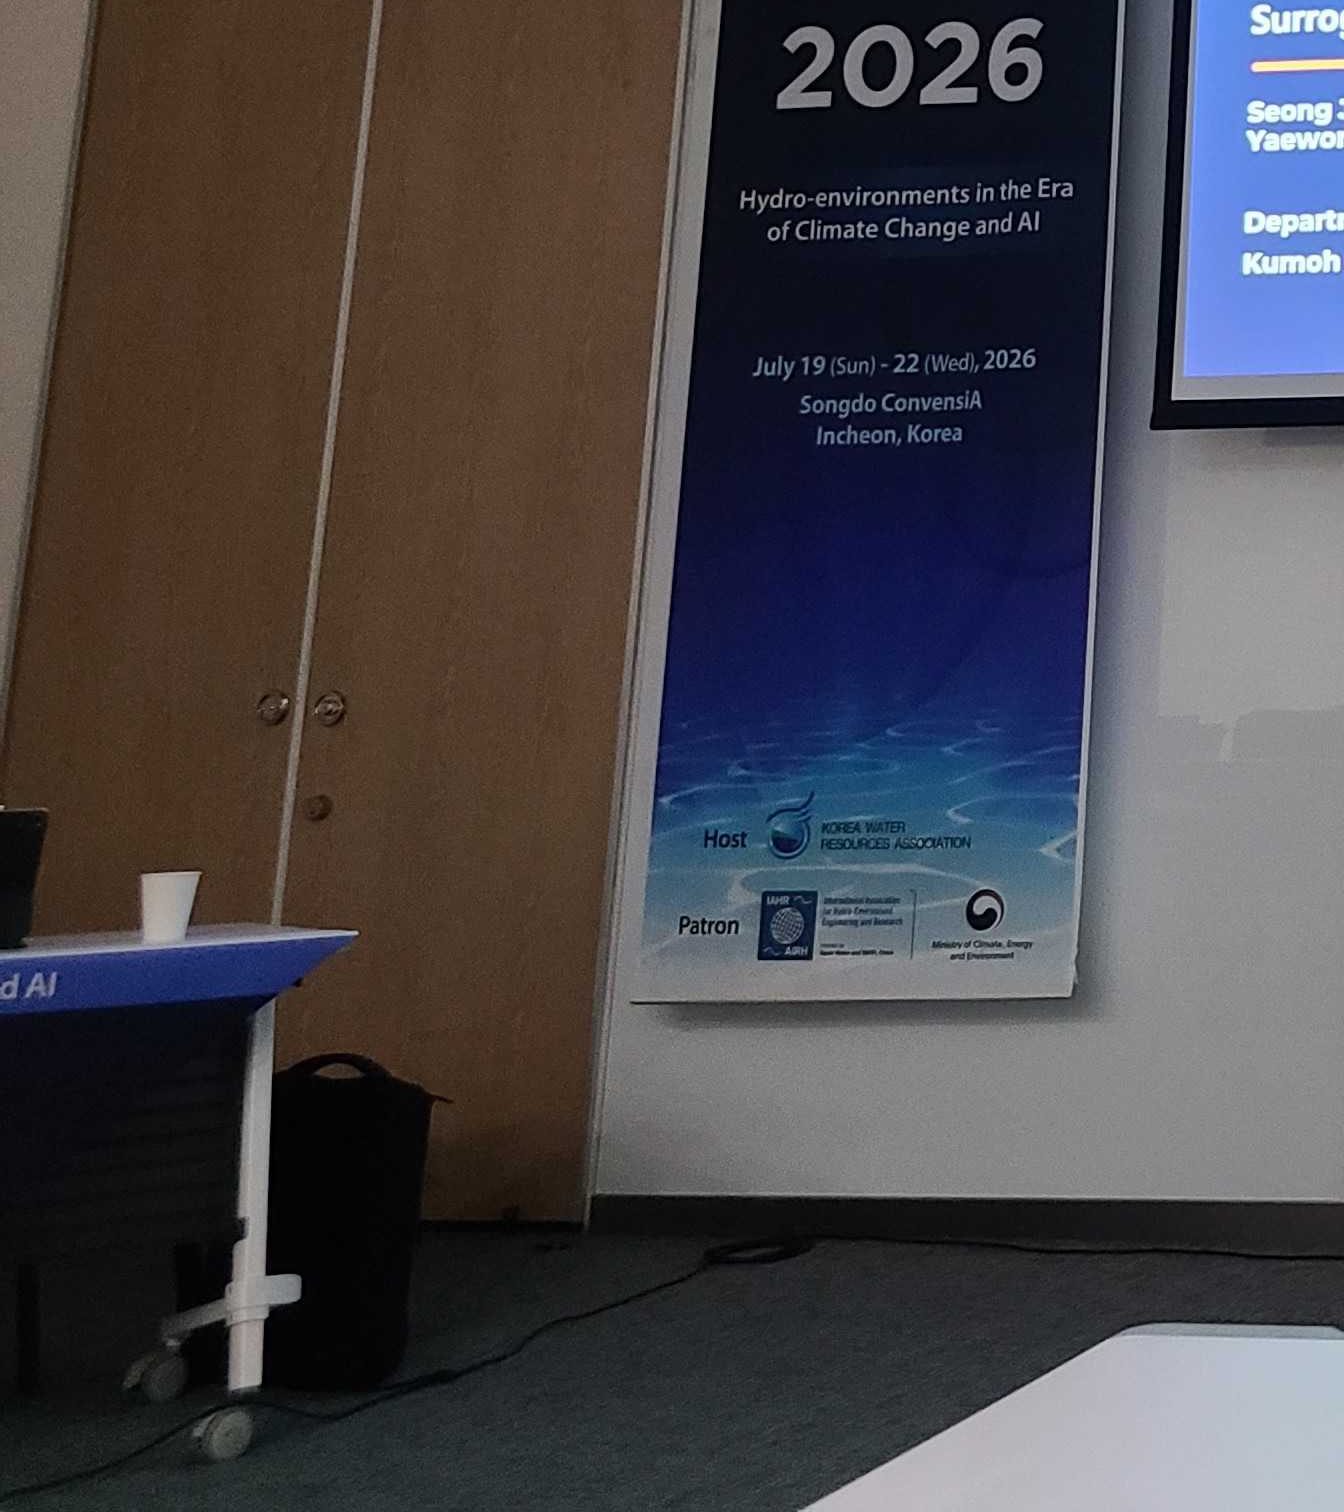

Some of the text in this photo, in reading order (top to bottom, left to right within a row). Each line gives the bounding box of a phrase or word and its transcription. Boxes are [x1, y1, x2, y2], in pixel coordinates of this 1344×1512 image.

[776, 17, 1045, 110] 2026
[1246, 99, 1333, 126] Seong
[739, 177, 1074, 215] Hydro-environments in the Era
[767, 210, 1041, 242] of Climate Change and AI
[1242, 249, 1341, 276] Kumoh
[752, 355, 795, 381] July
[801, 355, 826, 376] 19
[830, 355, 876, 376] (Sun)
[893, 353, 920, 373] 22
[924, 350, 980, 374] (Wed),
[983, 348, 1037, 370] 2026
[799, 389, 983, 419] Songdo ConvensiA
[816, 423, 964, 447] Incheon, Korea
[704, 829, 747, 849] Host
[820, 821, 906, 834] KOREA WATER
[820, 837, 971, 850] RESOURCES ASSOCIATION
[678, 917, 739, 936] Patron
[25, 972, 57, 998] AI
